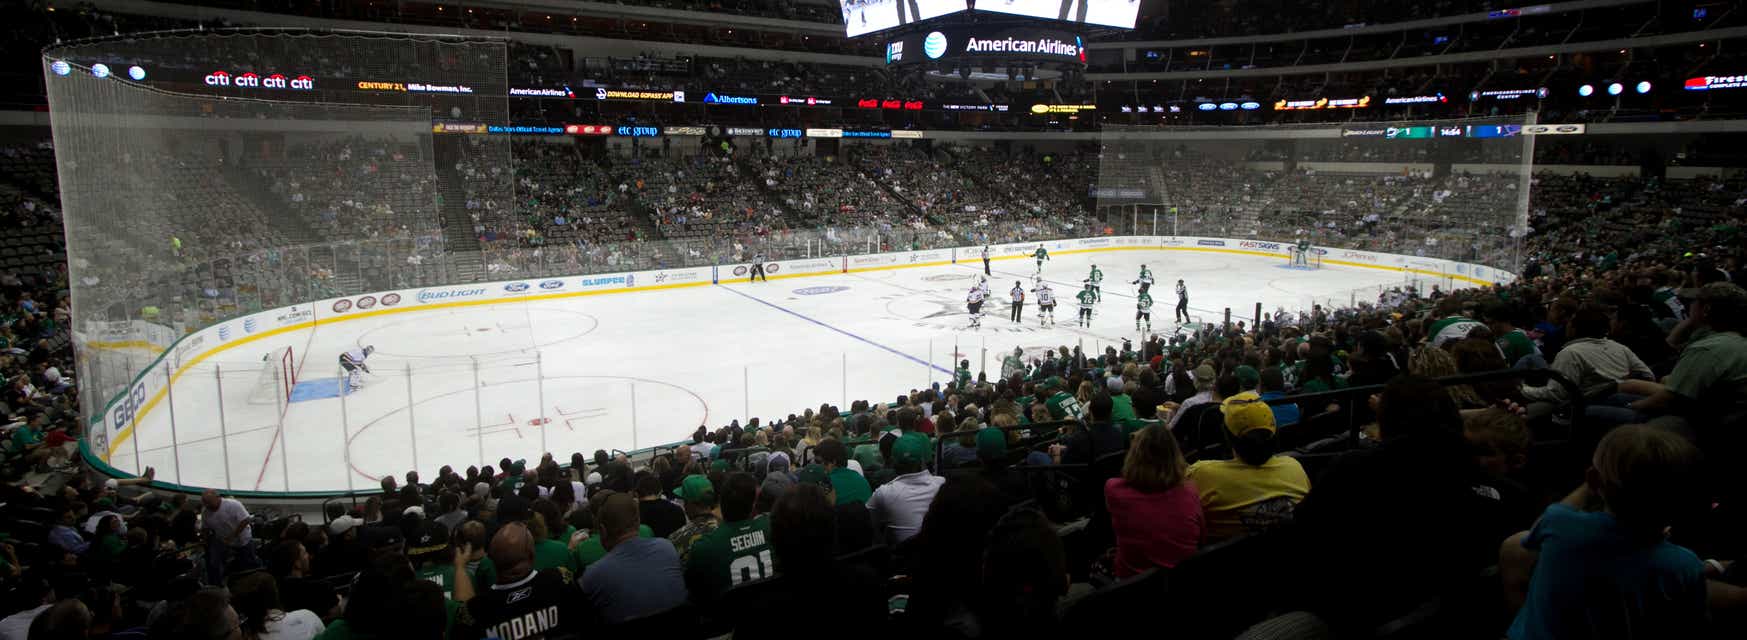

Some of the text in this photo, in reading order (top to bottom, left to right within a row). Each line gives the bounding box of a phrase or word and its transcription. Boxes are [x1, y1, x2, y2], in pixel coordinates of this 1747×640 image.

[966, 37, 1077, 56] American Airlines
[205, 73, 229, 85] citi
[235, 74, 258, 87] citi
[263, 76, 286, 88] citi
[290, 77, 313, 90] citi
[358, 81, 393, 89] CENTURY
[408, 83, 425, 91] Mike
[426, 84, 459, 92] Bowman,
[460, 85, 473, 93] Inc.
[510, 87, 541, 96] American
[719, 95, 758, 104] Albertsons
[618, 126, 632, 135] etc
[633, 126, 658, 136] group
[769, 128, 780, 136] etc
[781, 129, 801, 138] group
[1240, 241, 1281, 250] FASTSIGNS
[421, 288, 487, 299] BUD LIGHT
[114, 382, 146, 431] GECO
[730, 529, 766, 552] SEGUIN
